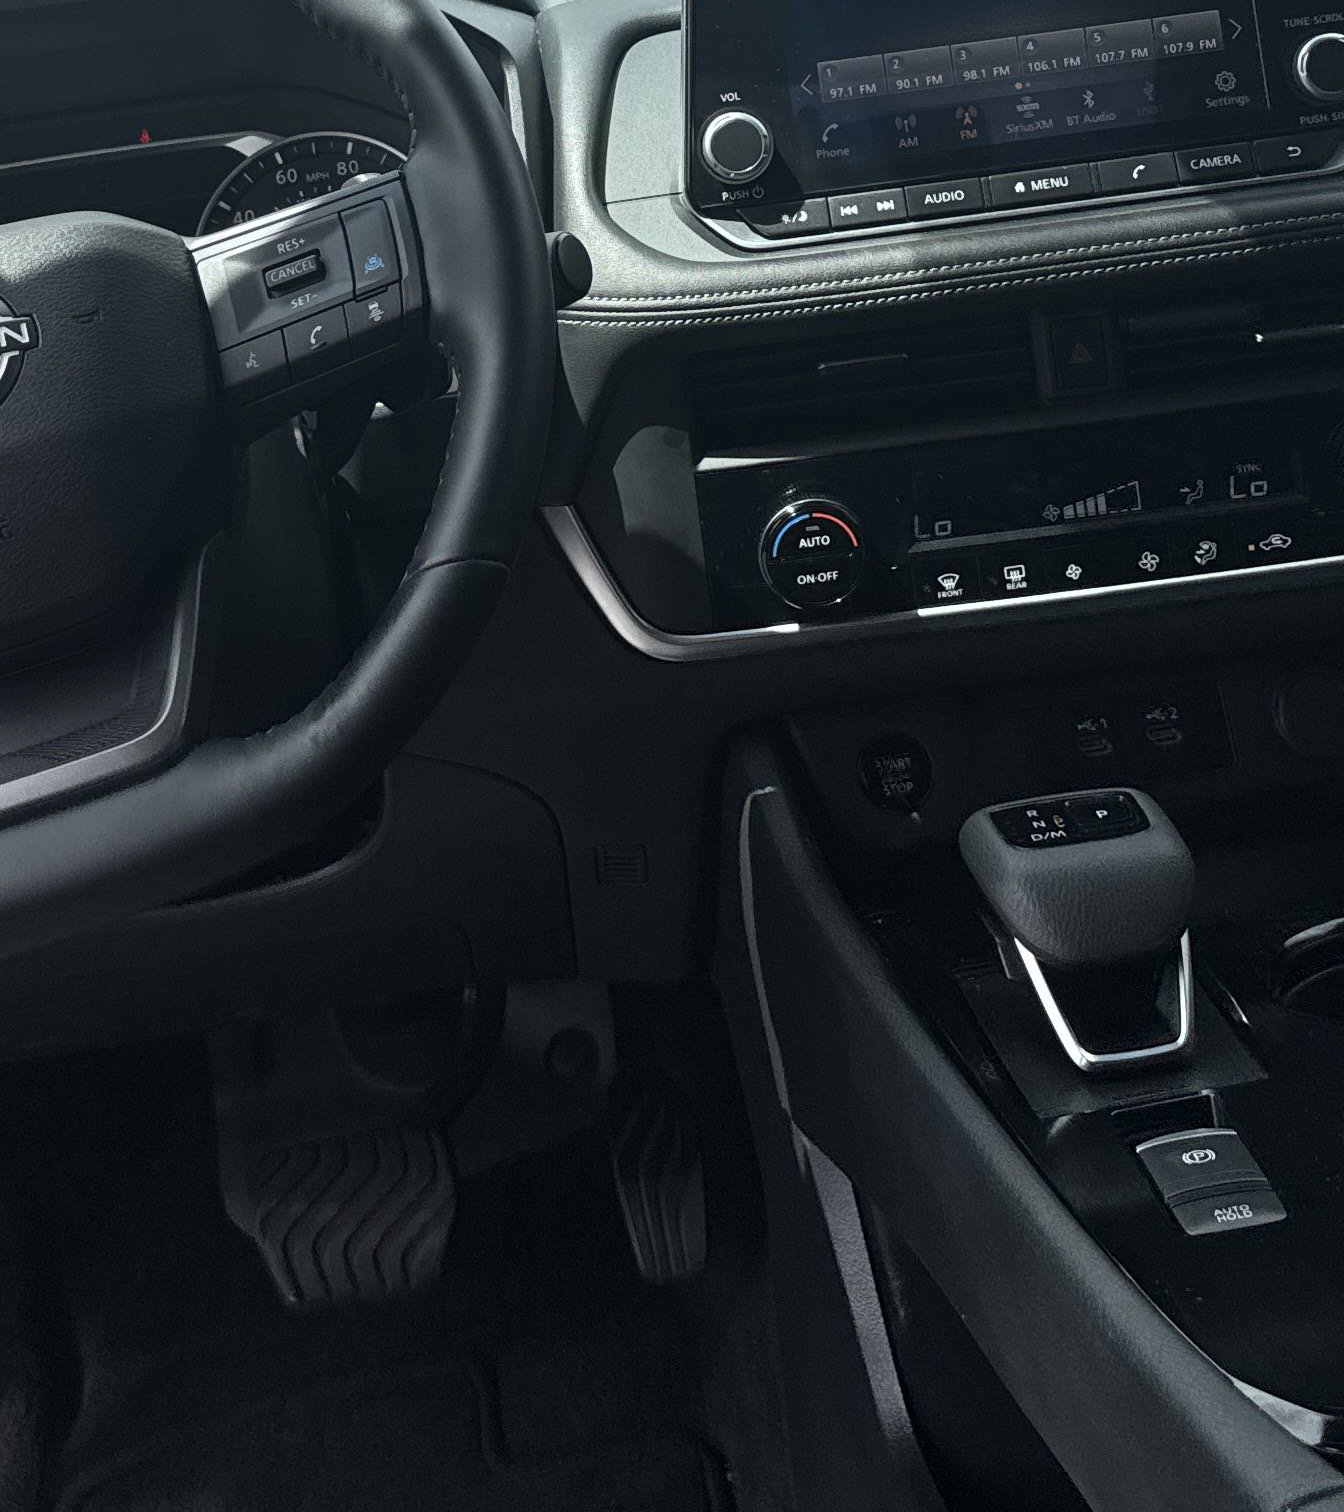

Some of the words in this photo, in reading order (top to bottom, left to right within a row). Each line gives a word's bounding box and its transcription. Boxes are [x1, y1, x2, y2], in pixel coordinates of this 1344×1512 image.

[1161, 24, 1169, 34] 6
[1093, 32, 1102, 43] 5
[1026, 41, 1035, 51] 4
[1163, 40, 1194, 55] 107.9
[1199, 38, 1217, 51] FM
[959, 50, 967, 61] 3
[1095, 50, 1125, 64] 107.7
[1131, 47, 1149, 60] FM
[892, 59, 900, 70] 2
[1027, 59, 1057, 72] 106.1
[1064, 56, 1081, 68] FM
[825, 67, 832, 78] 1
[962, 69, 987, 81] 98.1
[993, 65, 1011, 78] FM
[896, 78, 920, 90] 90.1
[926, 74, 944, 86] FM
[720, 91, 742, 103] VOL
[829, 86, 854, 99] 97.1
[859, 83, 877, 95] FM
[1205, 94, 1251, 109] Settings
[1066, 114, 1080, 127] BT
[1083, 110, 1116, 125] Audio
[1005, 118, 1054, 135] SiriusXM
[959, 129, 977, 141] FM
[898, 137, 919, 149] AM
[815, 146, 850, 160] Phone
[336, 161, 359, 176] 80
[1190, 153, 1242, 171] CAMERA
[275, 169, 298, 185] 60
[306, 172, 330, 183] MPH
[1031, 175, 1069, 191] MENU
[722, 190, 750, 201] PUSH
[924, 189, 965, 206] AUDIO
[233, 209, 255, 224] 40
[276, 237, 306, 255] RES+
[270, 260, 315, 282] CANCEL
[798, 535, 831, 549] AUTO
[1006, 580, 1028, 591] REAR
[937, 587, 964, 599] FRONT
[872, 757, 912, 771] START
[882, 780, 914, 797] STOP
[1026, 809, 1040, 818] R
[1095, 809, 1109, 820] P
[1032, 820, 1047, 829] N
[1030, 830, 1067, 843] D/M
[1214, 1204, 1250, 1217] AUTO
[1216, 1210, 1253, 1223] HOLD
